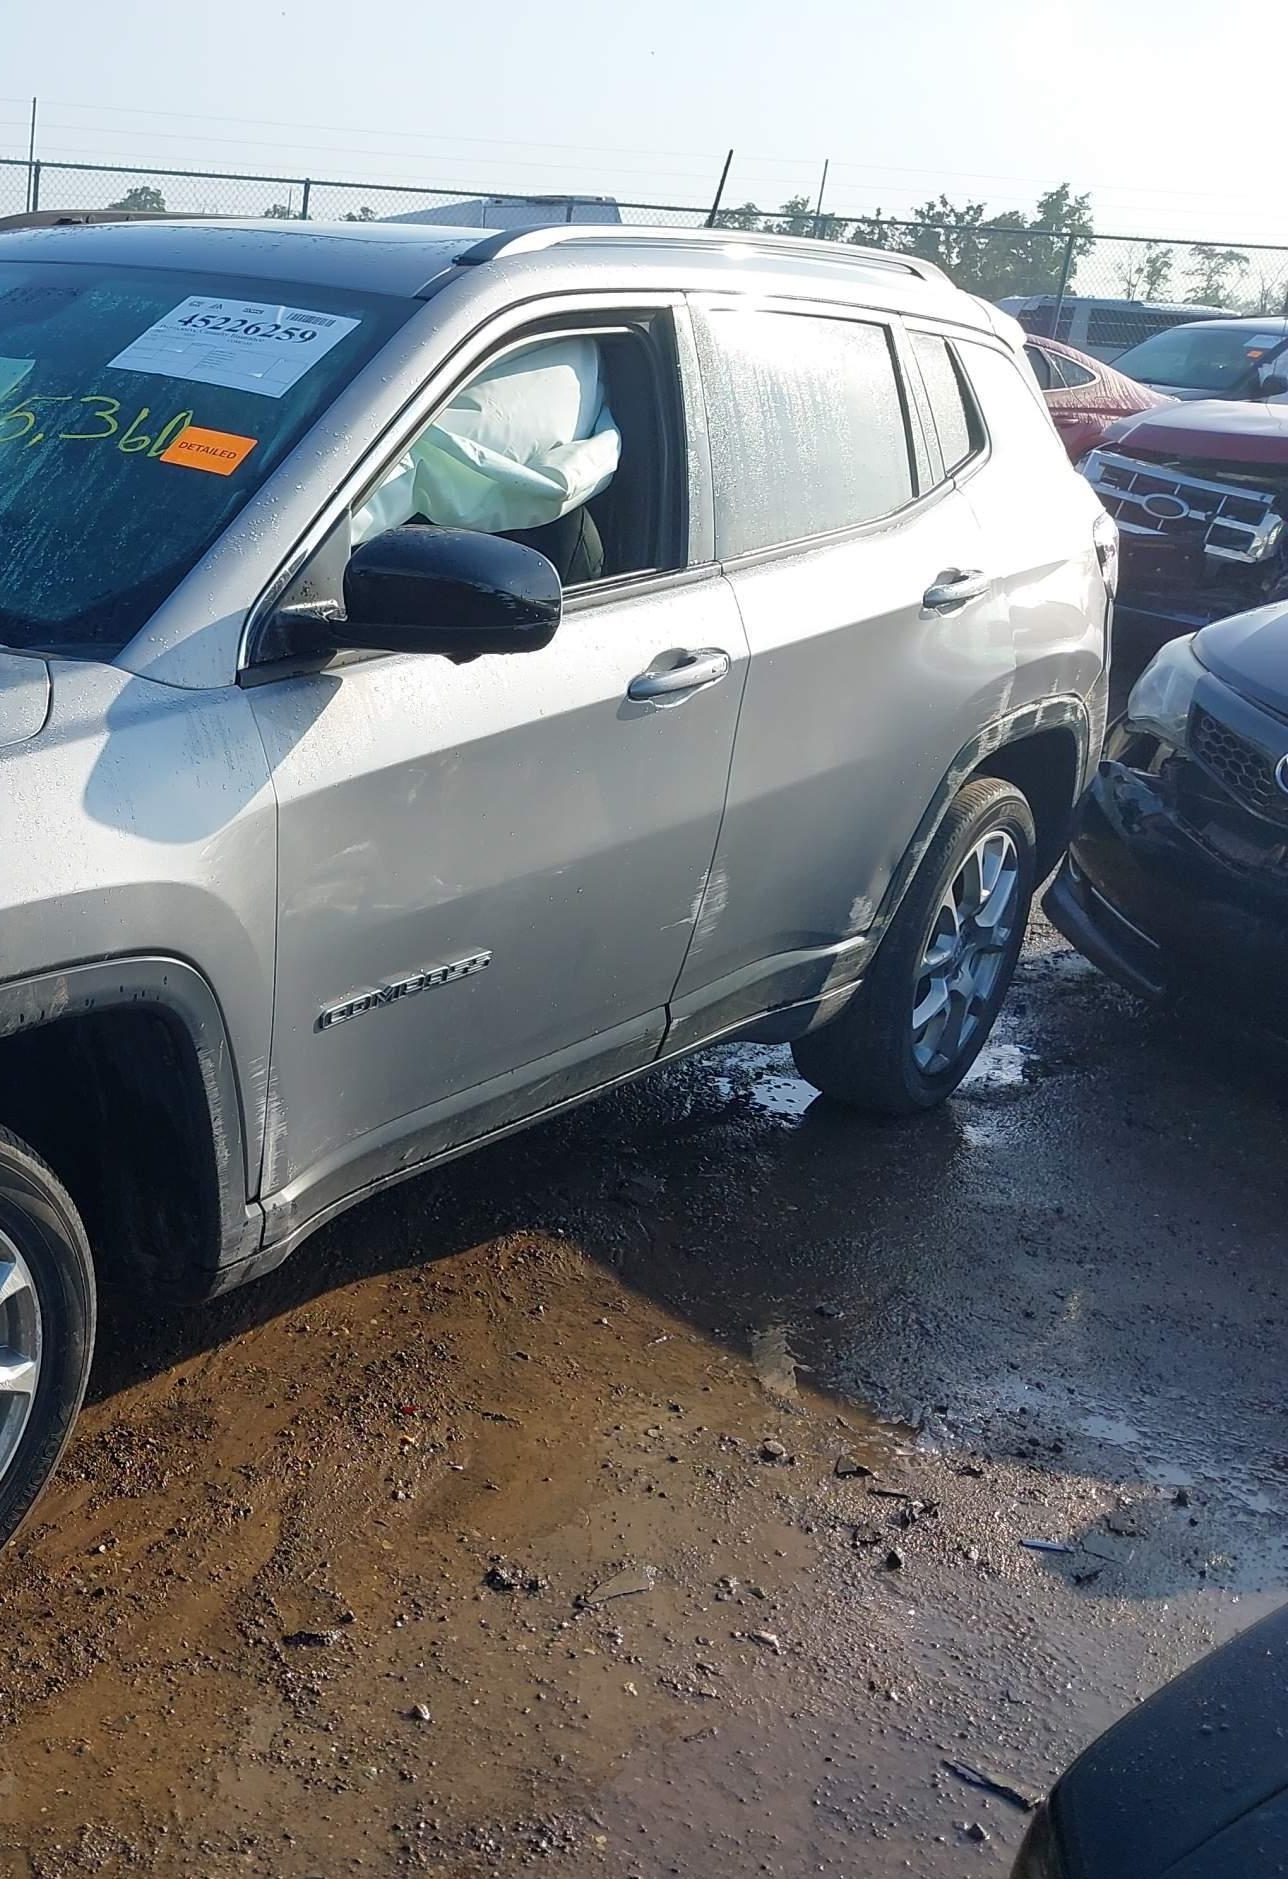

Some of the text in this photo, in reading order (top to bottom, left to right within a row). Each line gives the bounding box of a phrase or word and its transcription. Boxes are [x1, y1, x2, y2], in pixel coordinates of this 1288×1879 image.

[177, 312, 318, 344] 45226259
[178, 440, 238, 460] DETAILED
[316, 949, 494, 1030] COMPASS
